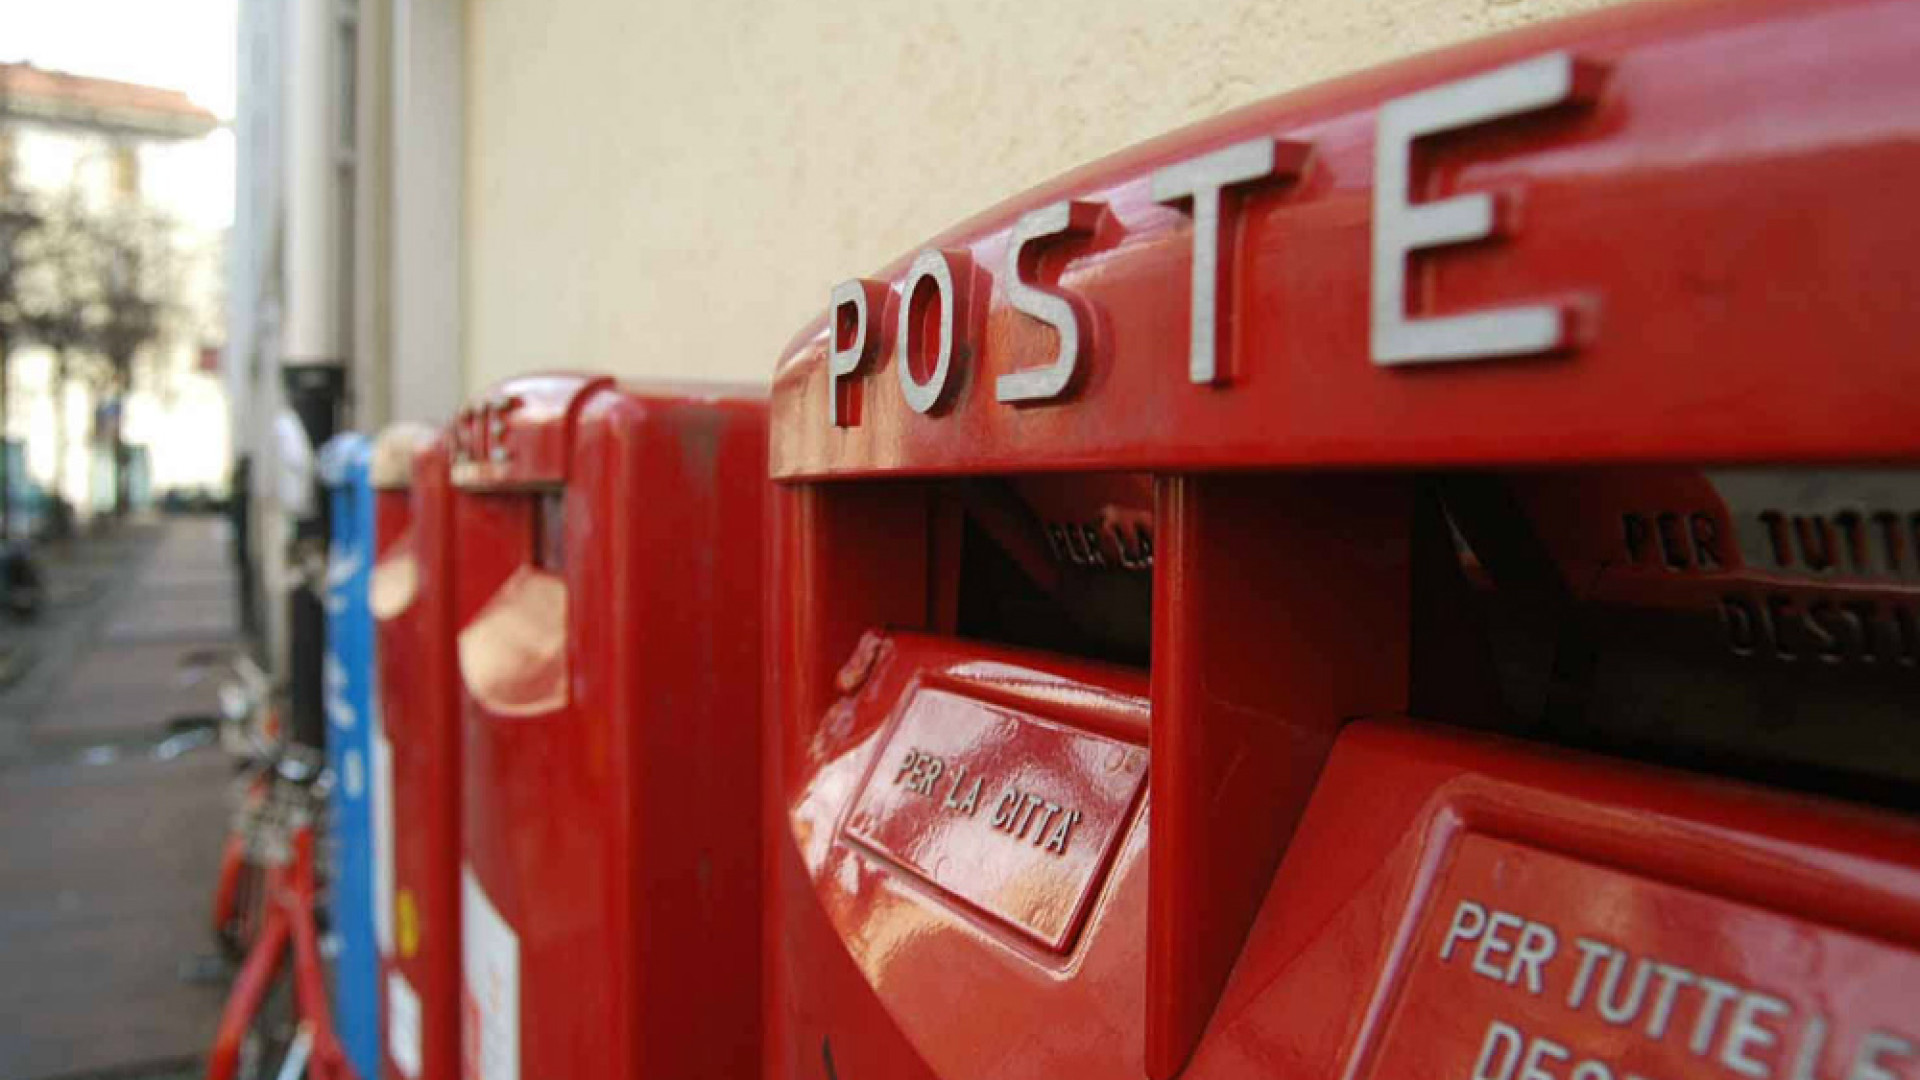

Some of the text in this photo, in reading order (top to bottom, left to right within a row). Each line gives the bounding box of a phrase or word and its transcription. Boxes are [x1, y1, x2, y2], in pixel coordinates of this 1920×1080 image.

[829, 50, 1590, 428] POSTE
[1049, 522, 1106, 566] PER
[1620, 511, 1724, 572] PER
[893, 748, 945, 796] PER
[946, 765, 985, 817] LA
[1439, 900, 1556, 993] PER
[1567, 937, 1790, 1078] TUTTE
